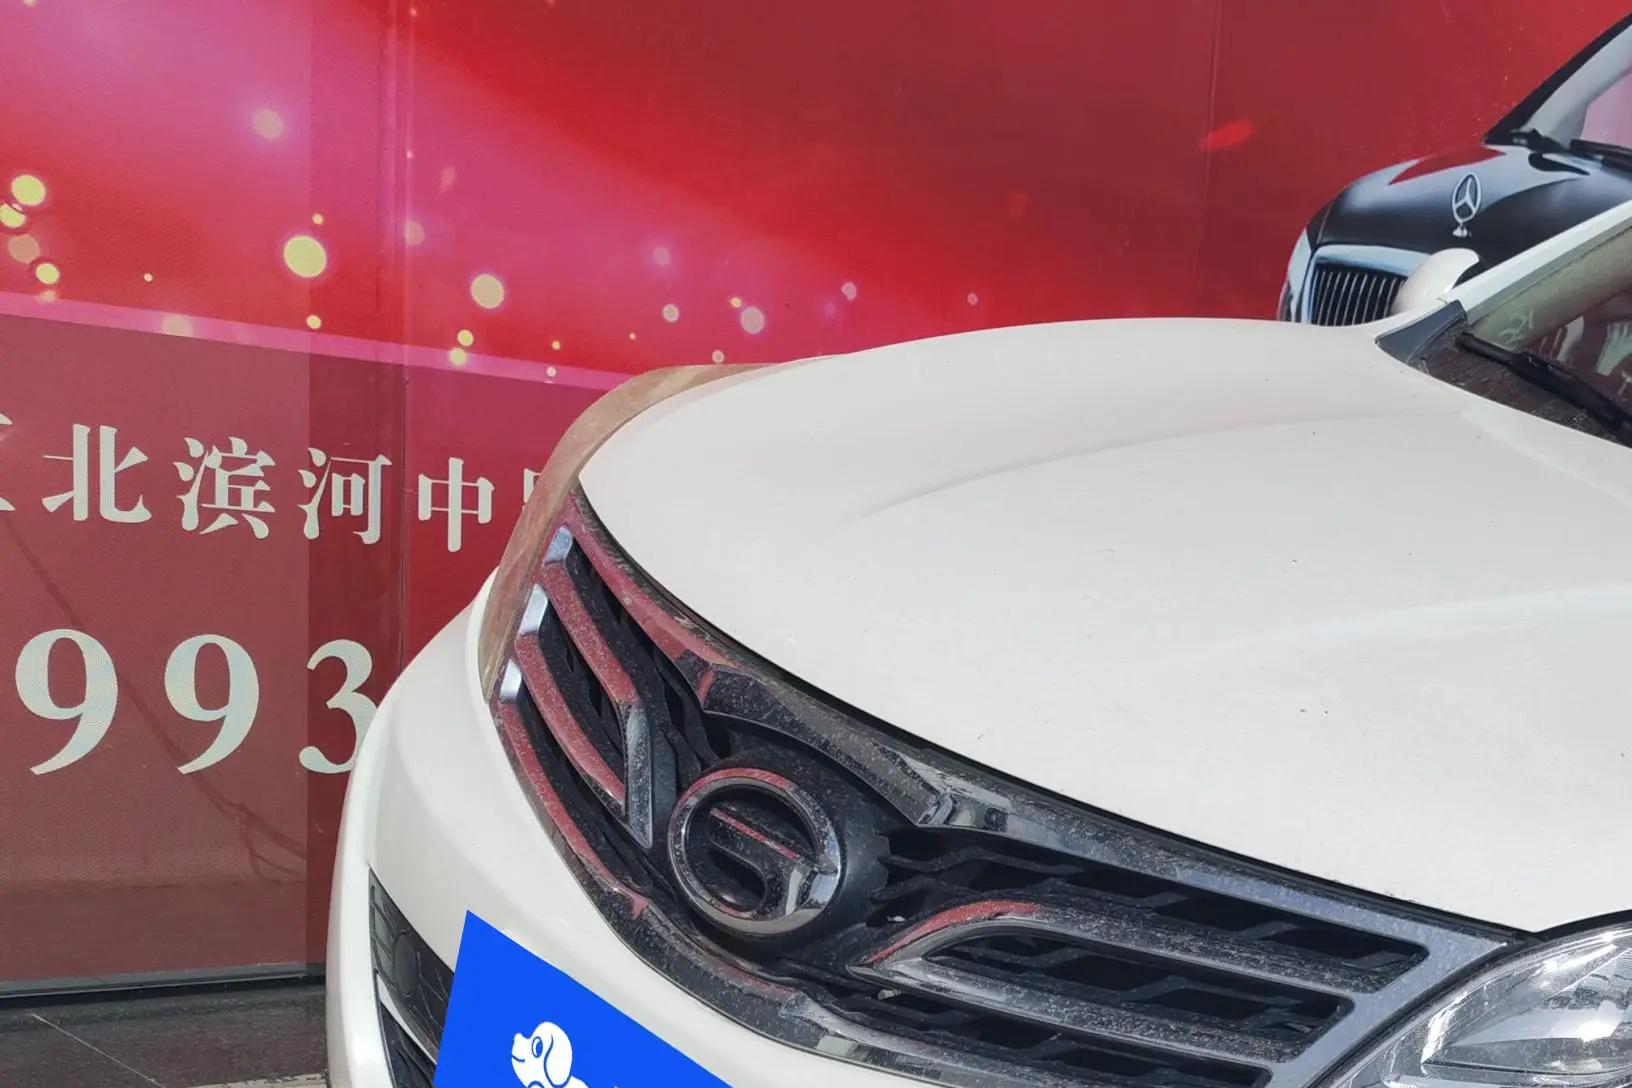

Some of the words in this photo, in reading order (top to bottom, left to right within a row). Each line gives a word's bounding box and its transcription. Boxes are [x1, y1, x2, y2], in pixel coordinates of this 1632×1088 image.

[0, 413, 541, 552] 北滨河中
[15, 629, 378, 775] 993
